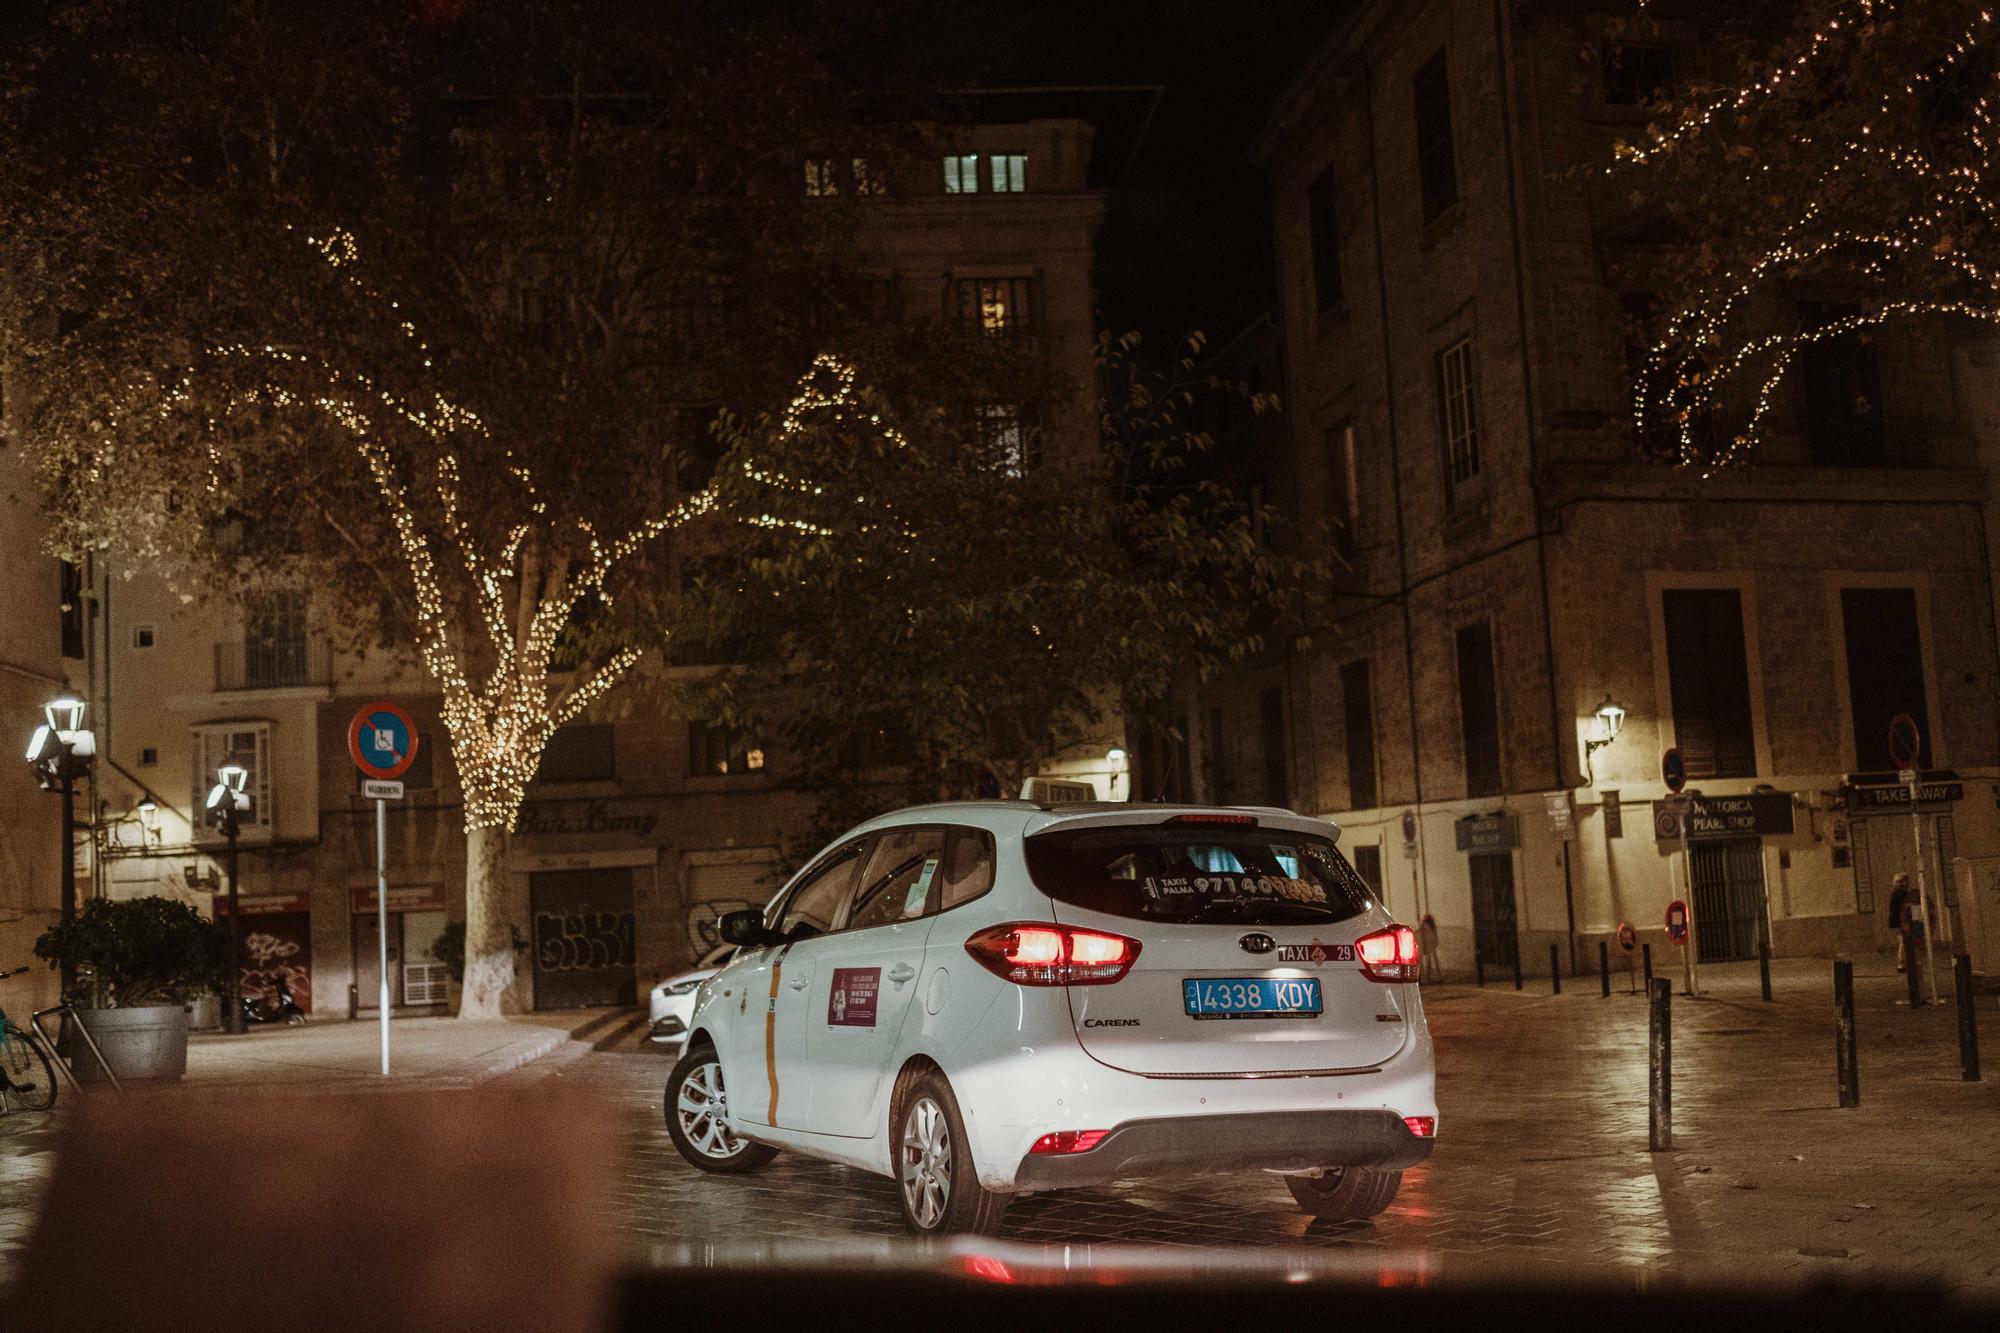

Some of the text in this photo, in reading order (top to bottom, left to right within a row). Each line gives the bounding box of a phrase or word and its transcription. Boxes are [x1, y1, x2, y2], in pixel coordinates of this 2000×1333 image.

[1874, 785, 1947, 802] TAKE AWAY
[1694, 817, 1726, 831] PEARL
[1161, 878, 1187, 886] TAXIS
[1194, 877, 1236, 894] 971
[1163, 886, 1195, 895] PALMA
[1278, 946, 1351, 961] TAXI 29
[1204, 983, 1313, 1009] 4338 KDY
[1190, 1000, 1197, 1008] E
[1084, 1019, 1140, 1028] CARENS
